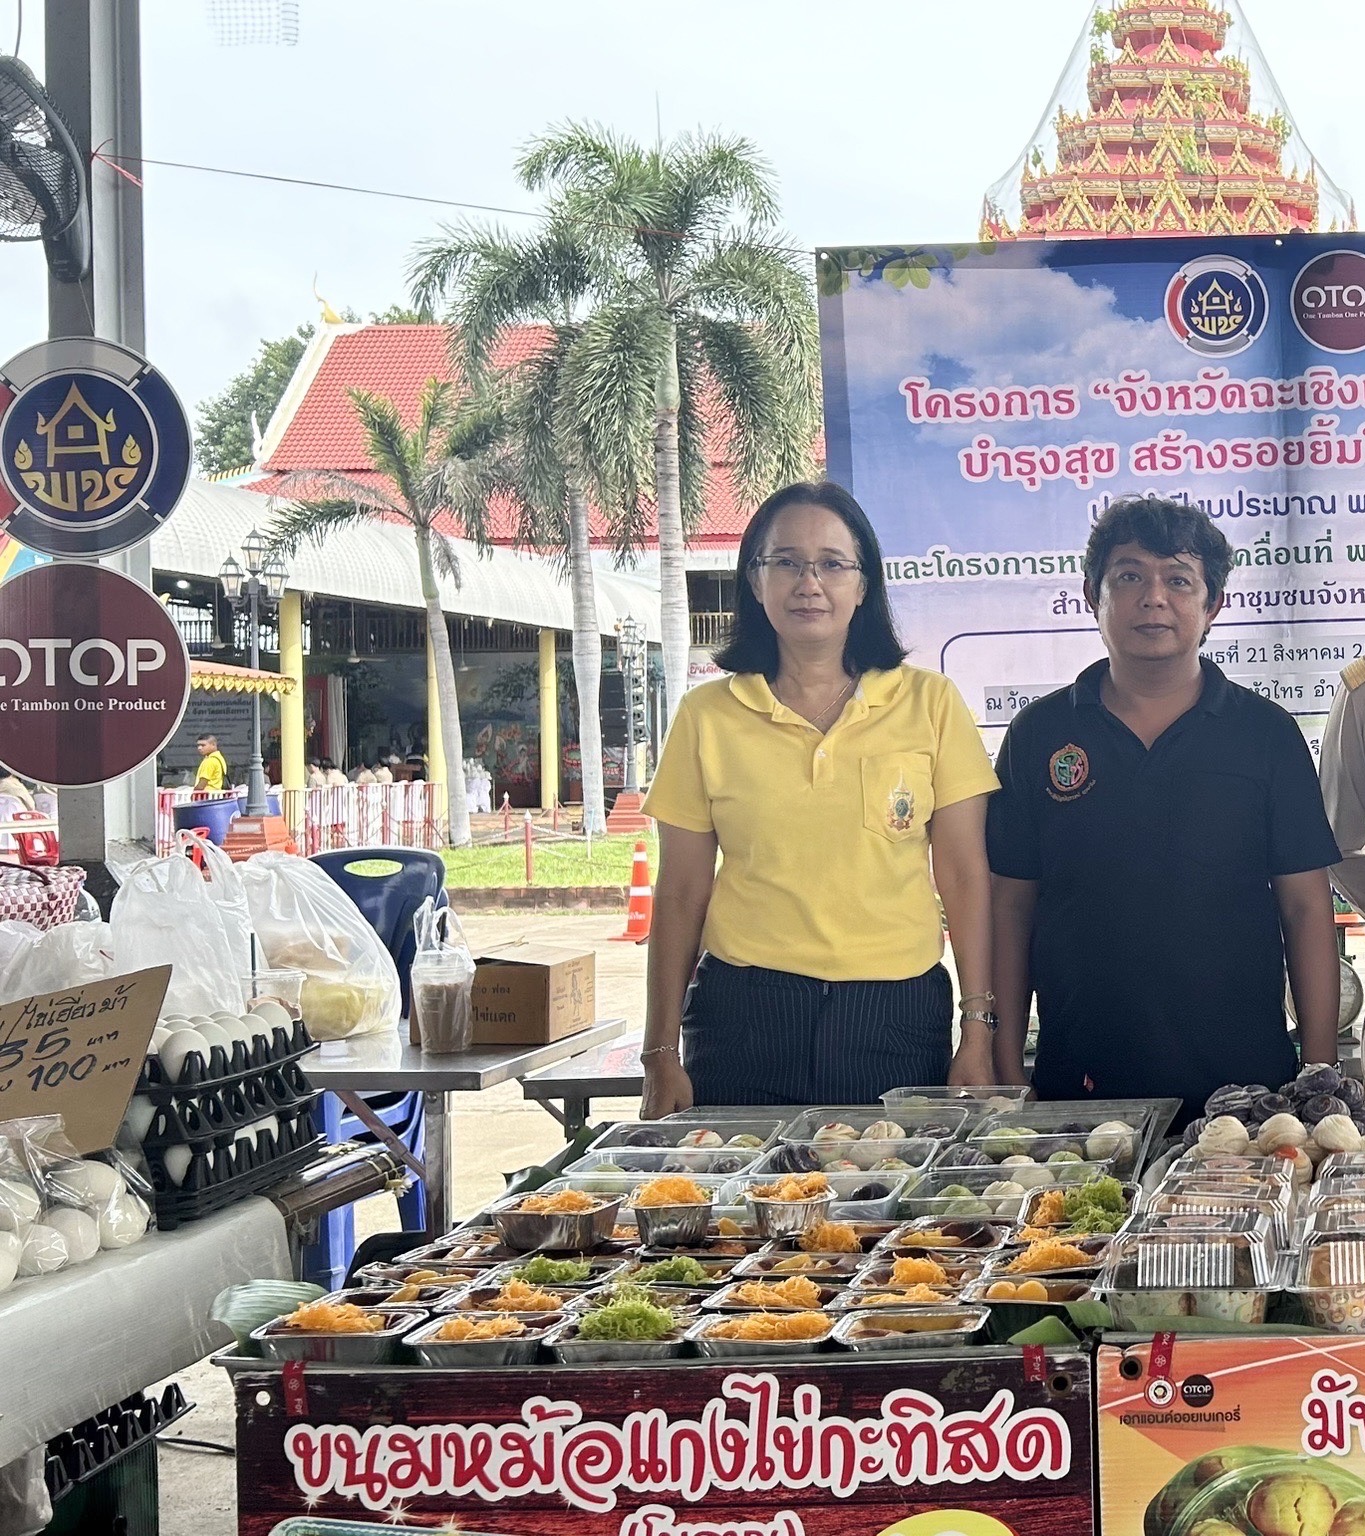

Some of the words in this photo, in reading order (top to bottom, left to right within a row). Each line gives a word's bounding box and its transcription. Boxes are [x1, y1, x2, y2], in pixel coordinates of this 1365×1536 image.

[1317, 311, 1343, 319] Tambon
[904, 381, 1077, 419] โครงการ
[963, 438, 1116, 486] บำรุงสุข
[1234, 528, 1333, 567] คลื่อนที่
[1246, 647, 1268, 663] 21
[1273, 643, 1345, 662] สิงหาคม
[1314, 678, 1338, 698] อำ
[11, 698, 70, 711] Tambon
[74, 698, 104, 711] One
[108, 698, 167, 711] Product
[985, 696, 1002, 711] ณ
[1006, 690, 1042, 710] วัด
[27, 1053, 98, 1092] 100
[1183, 1384, 1212, 1394] OTOP
[1119, 1404, 1241, 1426] เอกแอนด์ออยเบเกอรี่
[290, 1378, 1065, 1506] ขนมหม้อแกงไข่กะทิสด
